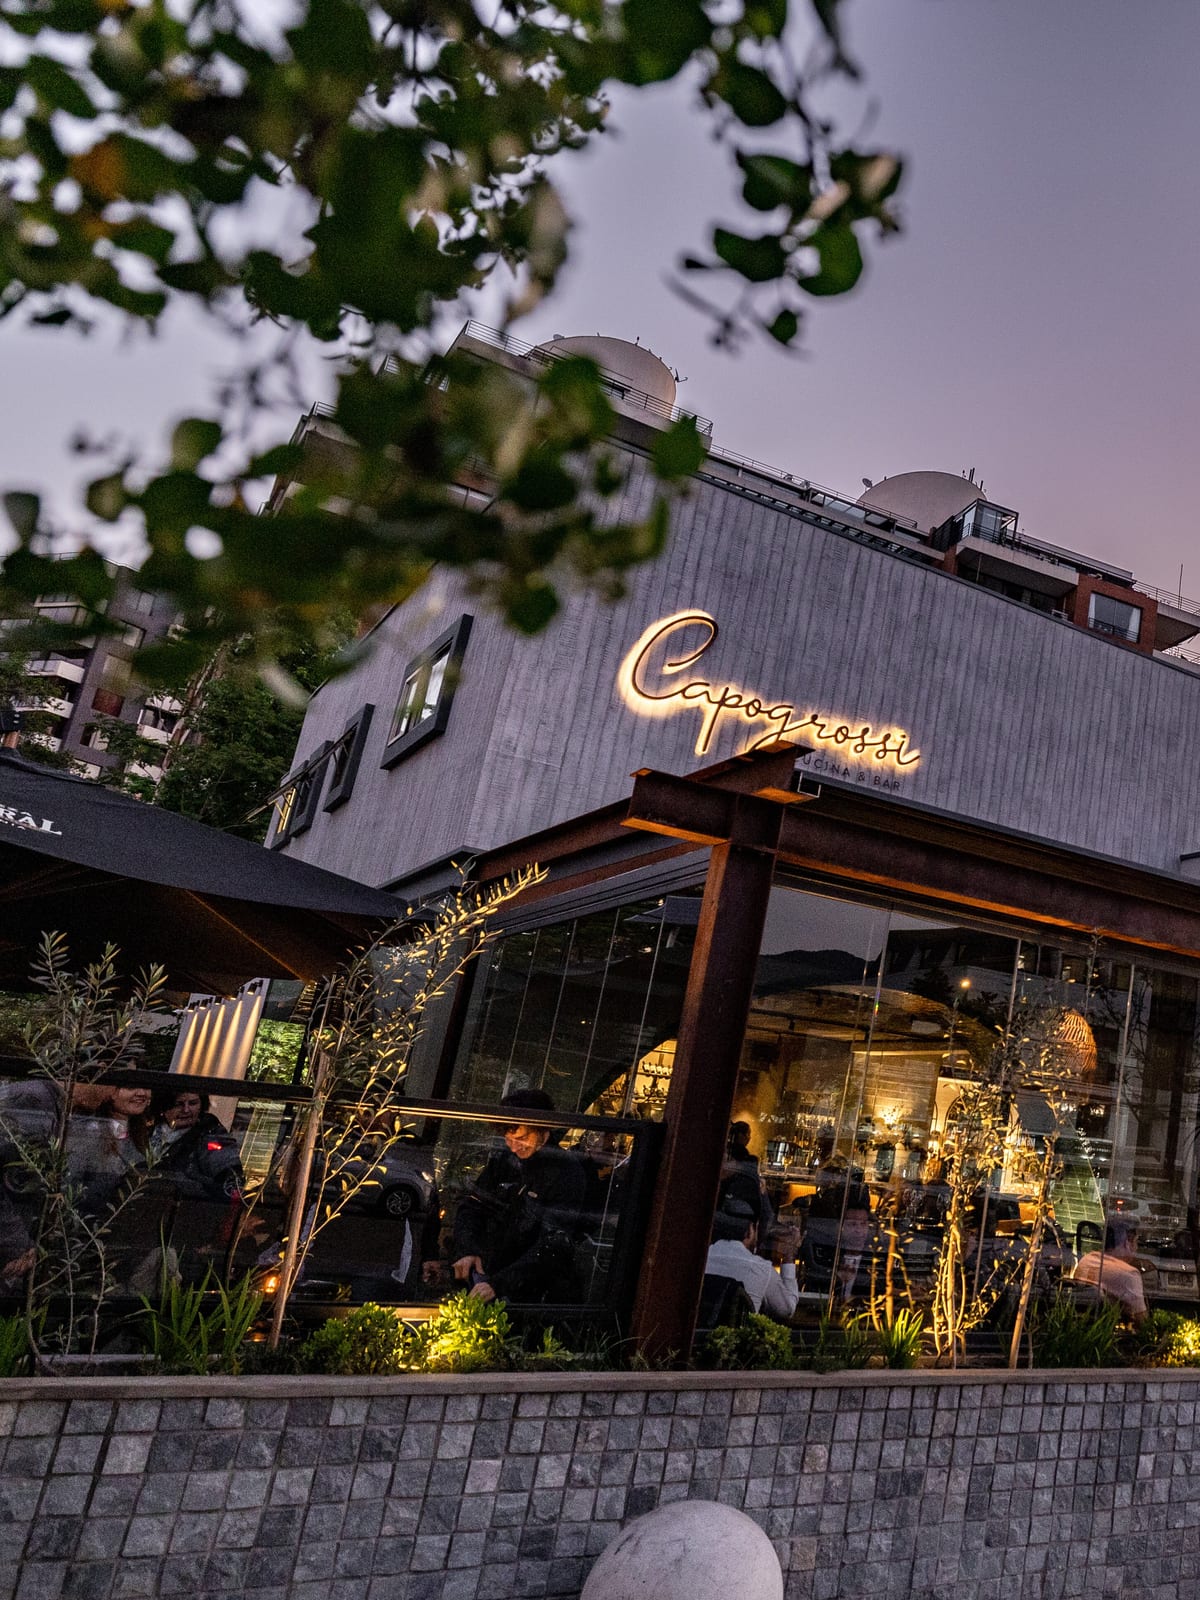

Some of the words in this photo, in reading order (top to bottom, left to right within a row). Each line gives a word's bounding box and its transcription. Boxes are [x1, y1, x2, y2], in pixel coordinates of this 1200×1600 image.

[631, 614, 921, 766] Capogrossi
[857, 771, 866, 782] &
[873, 775, 901, 791] BAR
